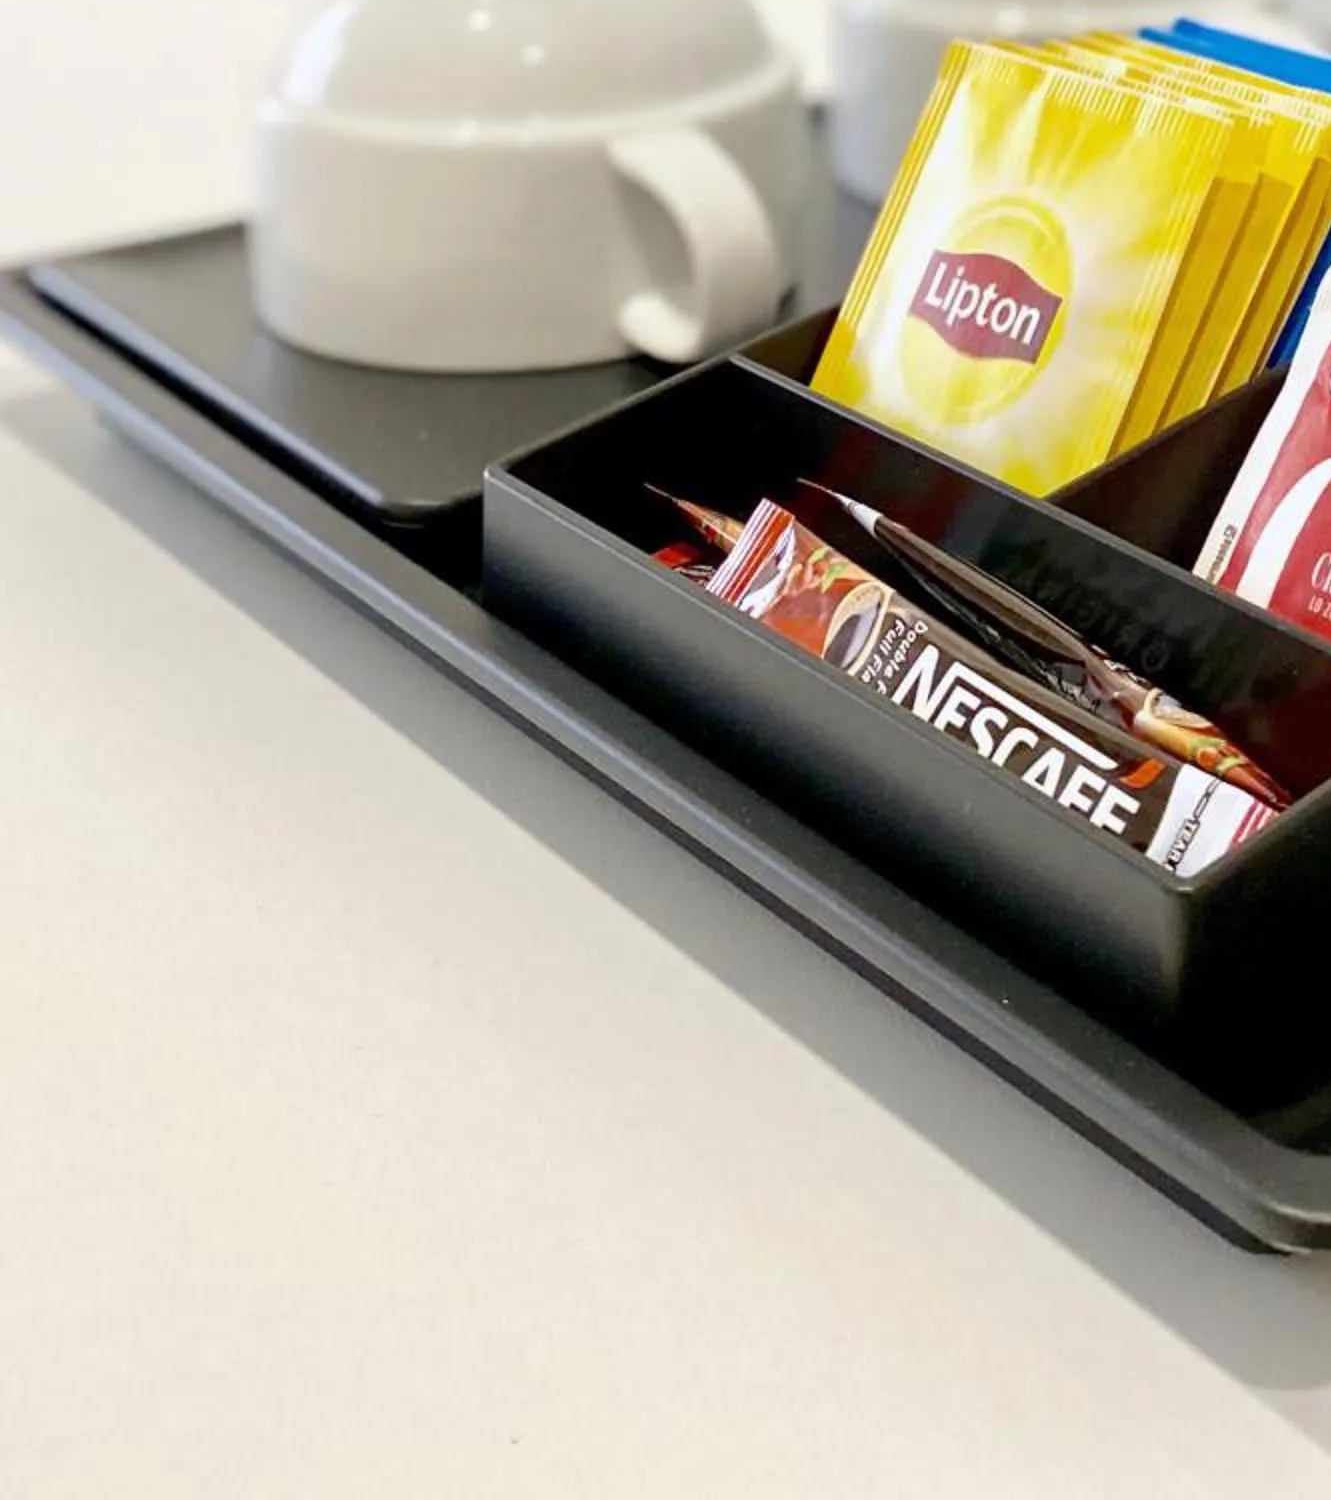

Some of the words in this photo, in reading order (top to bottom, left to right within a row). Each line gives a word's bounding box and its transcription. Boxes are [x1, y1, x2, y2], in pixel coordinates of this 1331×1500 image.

[924, 261, 1041, 345] Lipton
[1307, 596, 1321, 614] LO
[880, 619, 905, 656] Full
[884, 620, 928, 678] Double
